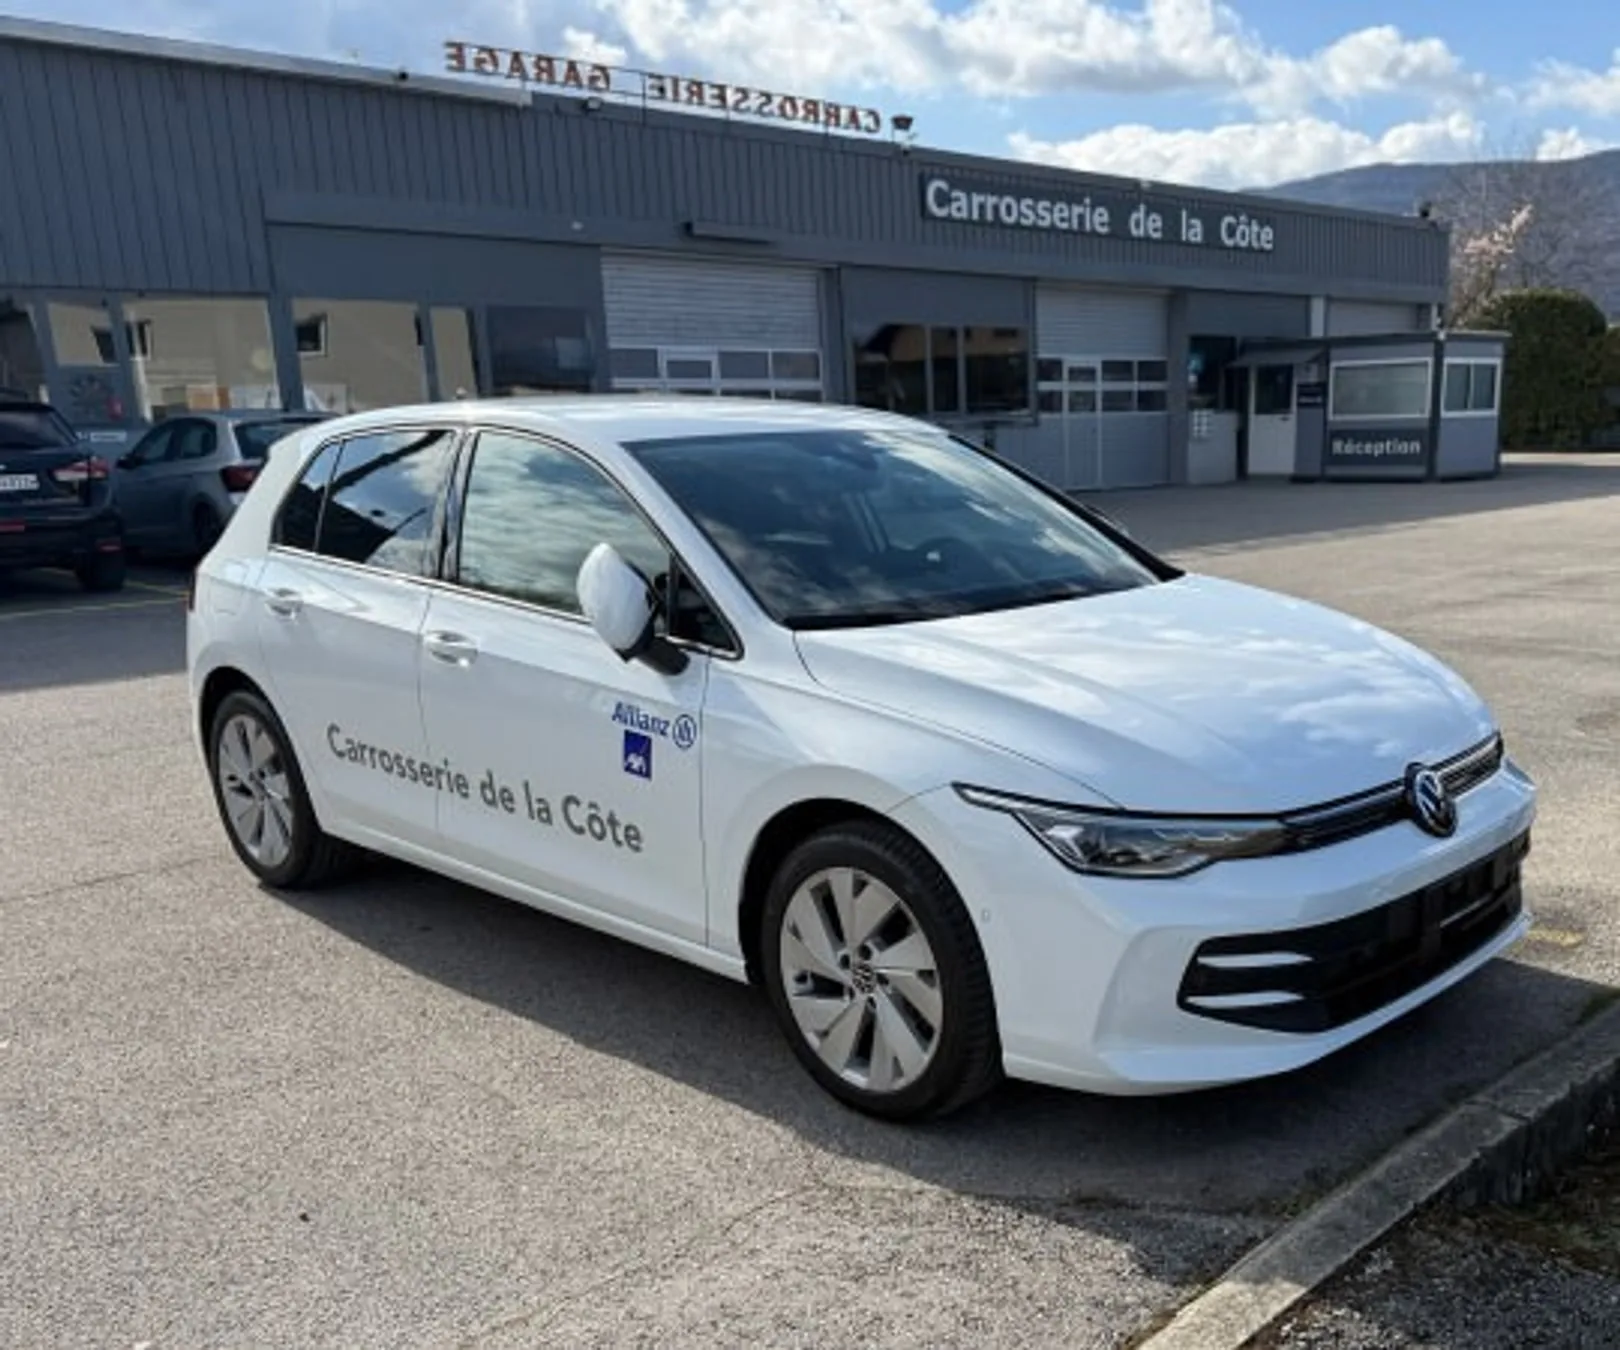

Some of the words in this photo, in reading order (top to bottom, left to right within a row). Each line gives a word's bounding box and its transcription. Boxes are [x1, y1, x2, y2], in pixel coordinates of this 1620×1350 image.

[925, 179, 1110, 235] Carrosserie
[1129, 203, 1163, 239] de
[1181, 209, 1204, 244] la
[1220, 213, 1274, 251] Côte
[1332, 438, 1421, 458] Réception
[611, 701, 670, 737] Allianz
[326, 722, 470, 799] Carrosserie
[479, 769, 516, 815] de
[523, 779, 553, 826] la
[560, 794, 644, 853] Côte
